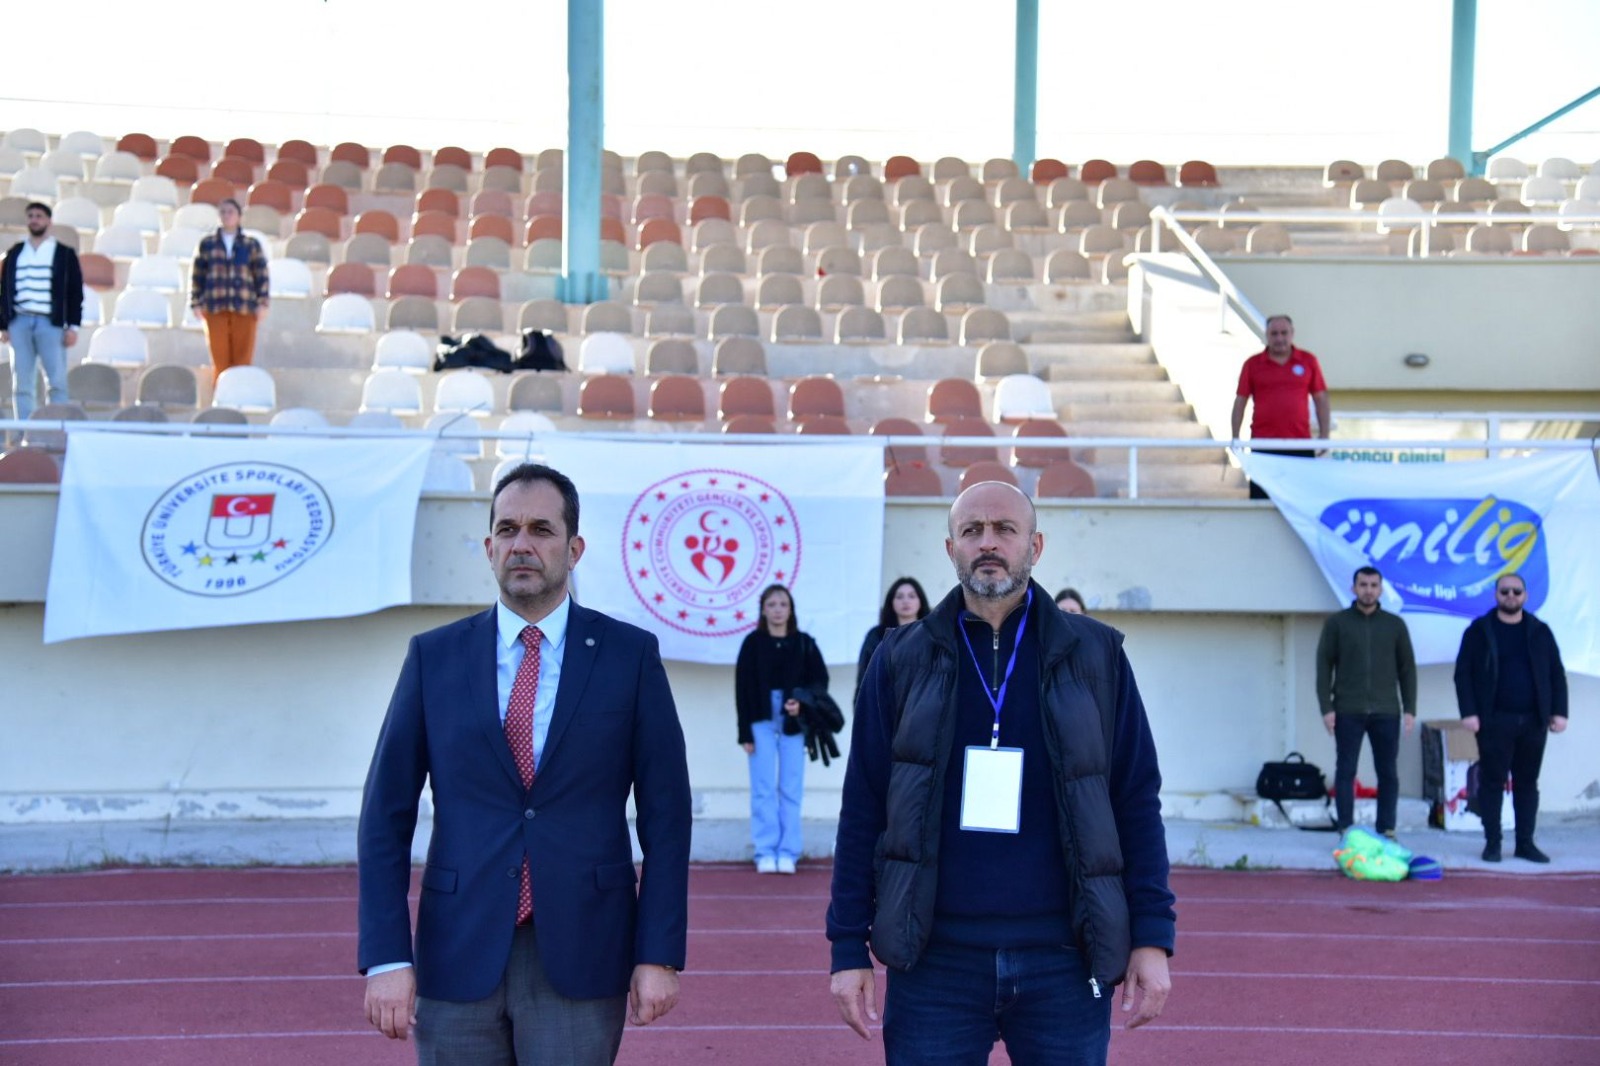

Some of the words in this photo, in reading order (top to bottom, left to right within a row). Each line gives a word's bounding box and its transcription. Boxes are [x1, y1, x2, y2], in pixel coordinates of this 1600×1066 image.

[1331, 449, 1393, 463] SPORCU
[152, 473, 231, 530] ÜNİVERSİTE
[235, 469, 308, 494] SPORLARI
[696, 493, 744, 509] GENÇLİK
[744, 505, 757, 519] VE
[754, 518, 769, 550] SPOR
[204, 575, 247, 590] 1996
